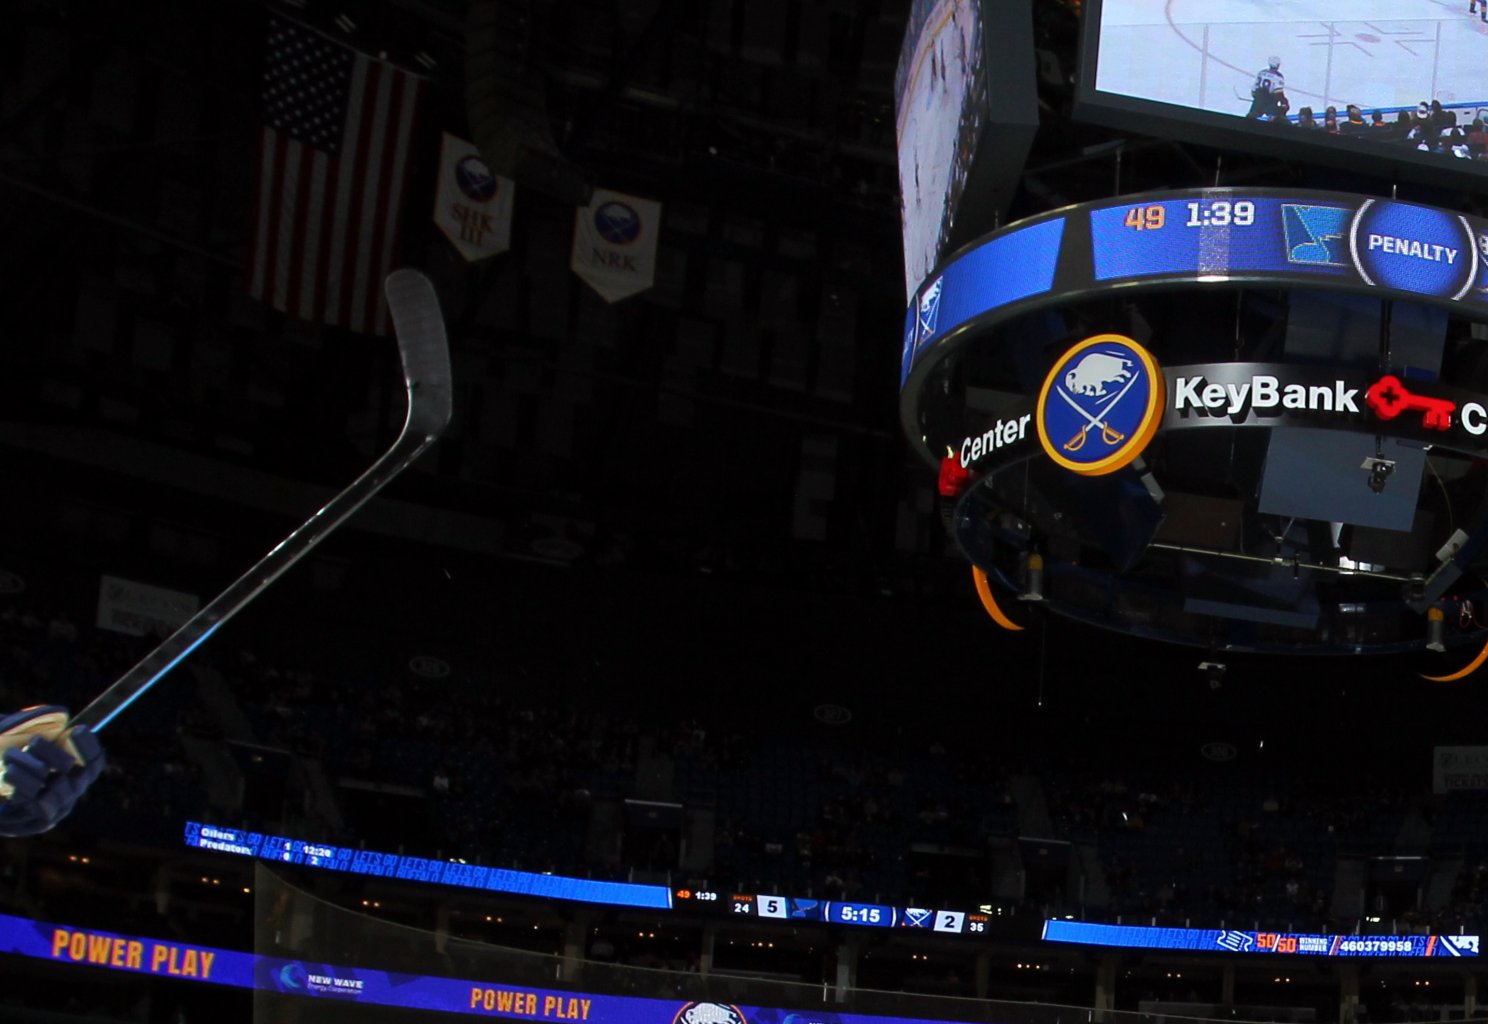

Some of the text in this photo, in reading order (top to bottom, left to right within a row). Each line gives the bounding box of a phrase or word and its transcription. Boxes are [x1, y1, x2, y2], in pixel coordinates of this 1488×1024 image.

[1123, 200, 1256, 231] 49 1:39
[1367, 233, 1458, 266] PENALTY
[592, 248, 636, 272] NRK
[1175, 375, 1360, 426] KeyBank
[960, 413, 1031, 469] Center
[201, 827, 235, 841] Oilers
[200, 838, 252, 856] Predators
[677, 890, 717, 901] 49 1:39
[734, 903, 749, 914] 24
[766, 900, 778, 914] 5
[840, 906, 881, 923] 5:15
[944, 915, 956, 929] 2
[1256, 933, 1296, 954] 50/50
[1340, 940, 1413, 952] 460379958
[53, 929, 215, 979] POWER PLAY
[308, 974, 364, 989] NEW WAVE
[470, 987, 593, 1021] POWER PLAY
